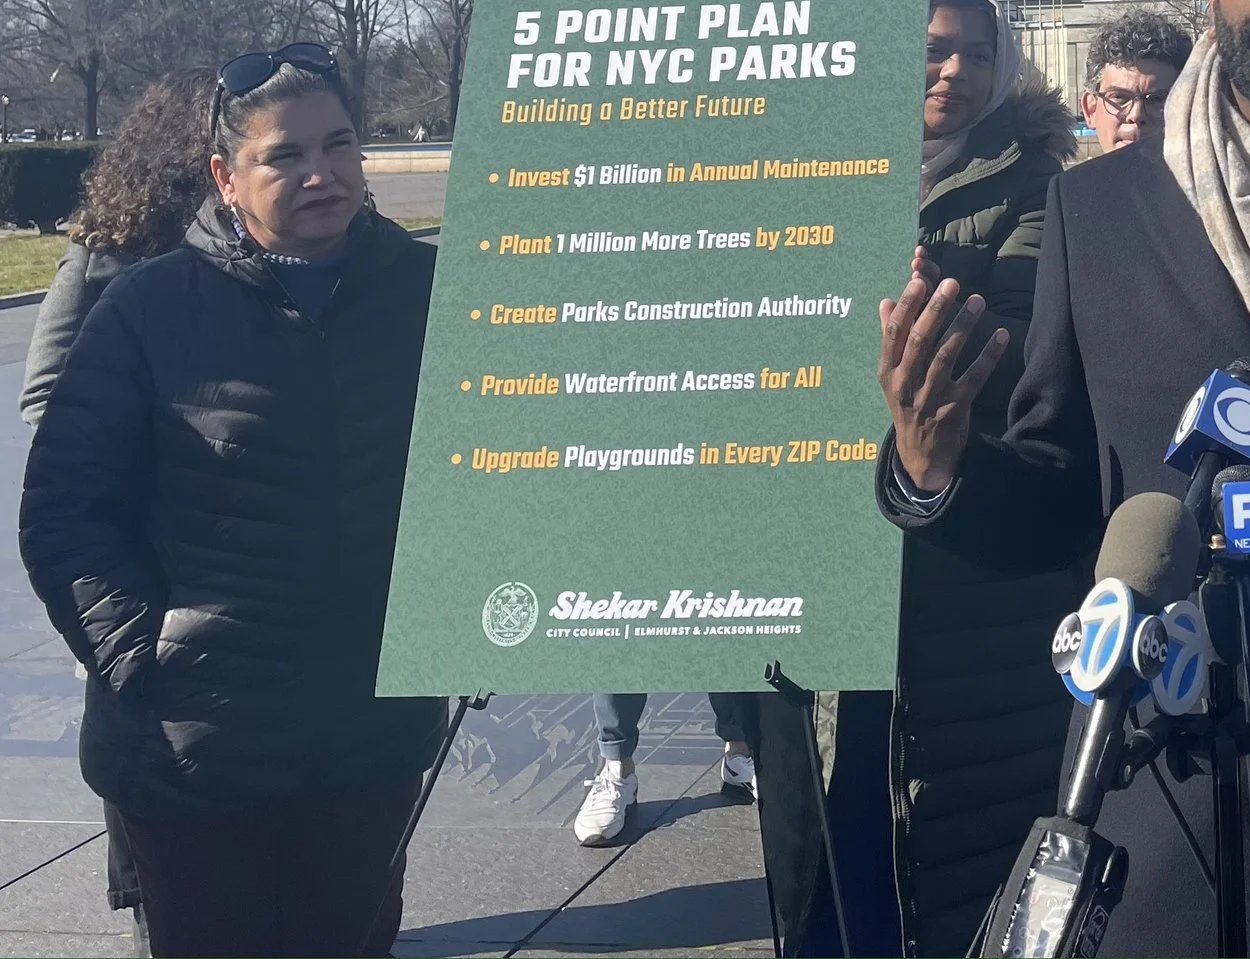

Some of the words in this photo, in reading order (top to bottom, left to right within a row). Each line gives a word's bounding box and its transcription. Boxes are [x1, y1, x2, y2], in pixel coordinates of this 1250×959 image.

[513, 10, 542, 46] 5
[554, 5, 686, 45] POINT
[697, 0, 811, 40] PLAN
[506, 51, 592, 89] FOR
[605, 47, 695, 86] NYC
[708, 40, 857, 82] PARKS
[501, 97, 593, 126] Building
[599, 102, 613, 121] a
[619, 97, 689, 120] Better
[695, 94, 766, 118] Future
[508, 168, 571, 187] Invest
[572, 164, 595, 188] $1
[599, 163, 662, 185] Billion
[666, 162, 685, 183] in
[689, 159, 759, 182] Annual
[763, 157, 890, 179] Maintenance
[499, 234, 553, 255] Plant
[556, 233, 565, 254] 1
[568, 231, 637, 253] Million
[641, 231, 692, 251] More
[696, 229, 751, 250] Trees
[755, 226, 781, 251] by
[784, 224, 835, 247] 2030
[490, 304, 557, 325] Create
[561, 300, 620, 323] Parks
[624, 297, 753, 321] Construction
[757, 293, 852, 318] Authority
[480, 372, 560, 396] Provide
[564, 370, 678, 394] Waterfront
[680, 370, 756, 392] Access
[760, 367, 791, 389] for
[793, 365, 822, 388] All
[471, 445, 560, 474] Upgrade
[564, 442, 695, 471] Playgrounds
[699, 442, 720, 465] in
[724, 442, 782, 467] Every
[786, 440, 821, 463] ZIP
[825, 438, 878, 462] Code
[548, 590, 658, 620] Shekar
[659, 589, 804, 619] Krishnan
[546, 628, 571, 638] CITY
[572, 627, 621, 638] COUNCIL
[634, 626, 691, 637] ELMHURST
[692, 626, 701, 636] &
[703, 625, 754, 636] JACKSON
[755, 624, 802, 635] HEIGHTS
[1052, 627, 1083, 654] abc
[1079, 594, 1123, 682] 7
[1141, 632, 1168, 663] abc
